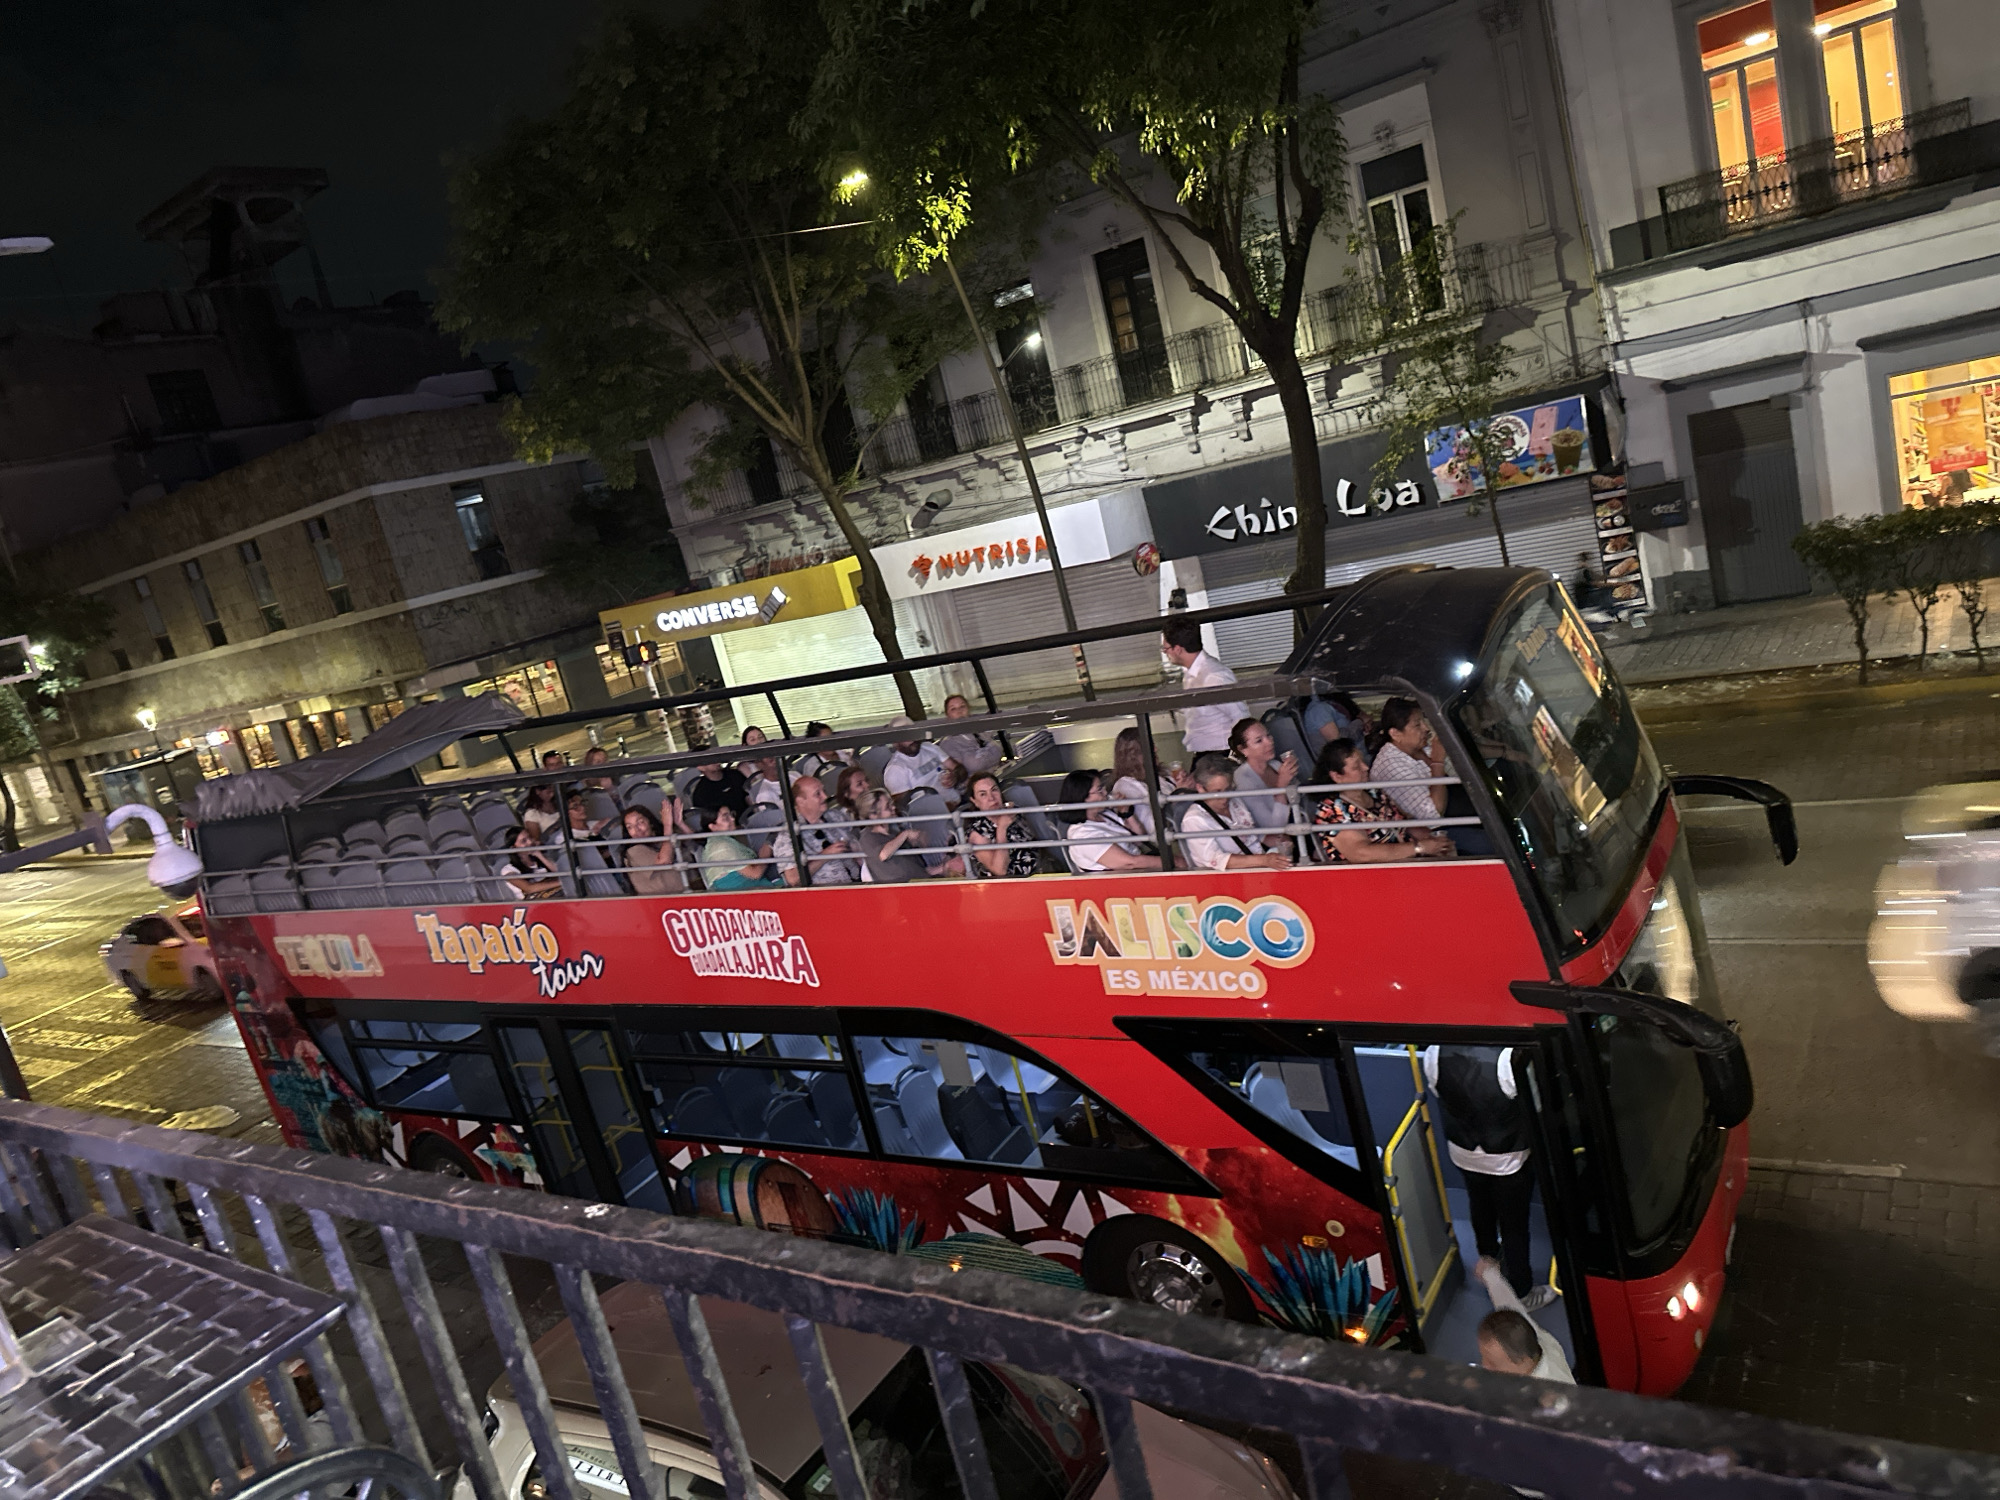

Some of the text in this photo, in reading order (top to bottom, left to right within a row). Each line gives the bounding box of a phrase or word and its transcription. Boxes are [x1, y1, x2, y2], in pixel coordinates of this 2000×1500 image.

[1204, 497, 1299, 540] Chin
[938, 534, 1048, 570] NUTRISA
[657, 594, 760, 632] CONVERSE
[414, 908, 559, 973] Tapatío
[664, 910, 783, 954] GUADALAJARA
[1051, 901, 1306, 962] JALISCO
[275, 934, 384, 979] TEQUILA
[532, 952, 604, 999] tour
[692, 937, 818, 984] GUADALAJARA
[1106, 965, 1261, 993] ES MÉXICO
